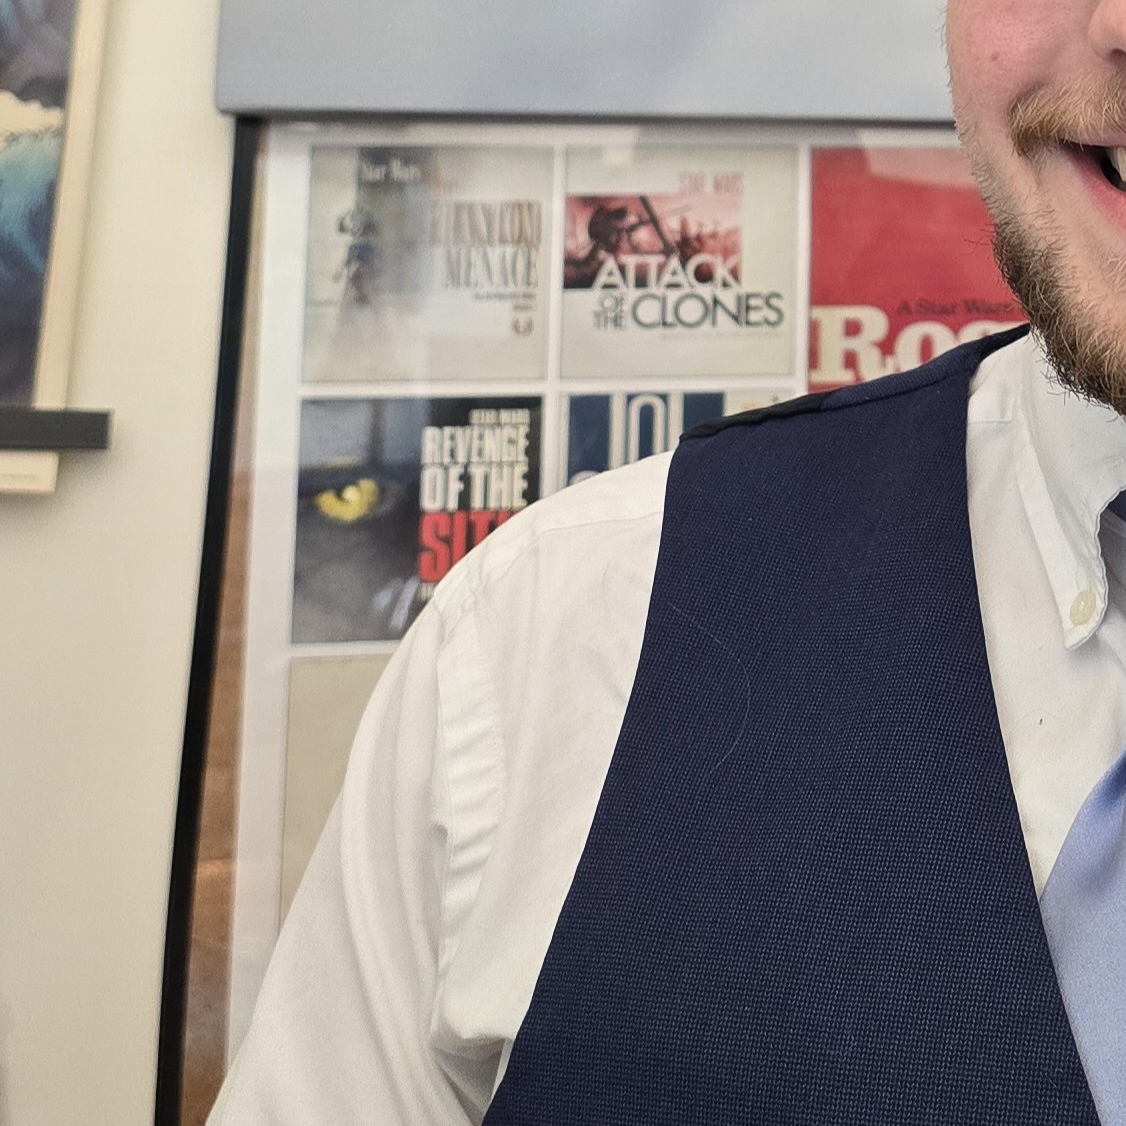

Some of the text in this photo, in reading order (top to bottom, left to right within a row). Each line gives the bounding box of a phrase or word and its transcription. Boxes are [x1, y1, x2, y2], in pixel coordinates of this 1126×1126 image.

[591, 253, 741, 290] ATTACK
[631, 291, 785, 330] CLONES
[421, 425, 530, 466] REVENGE
[420, 460, 528, 511] OF THE
[418, 509, 524, 583] SIT
